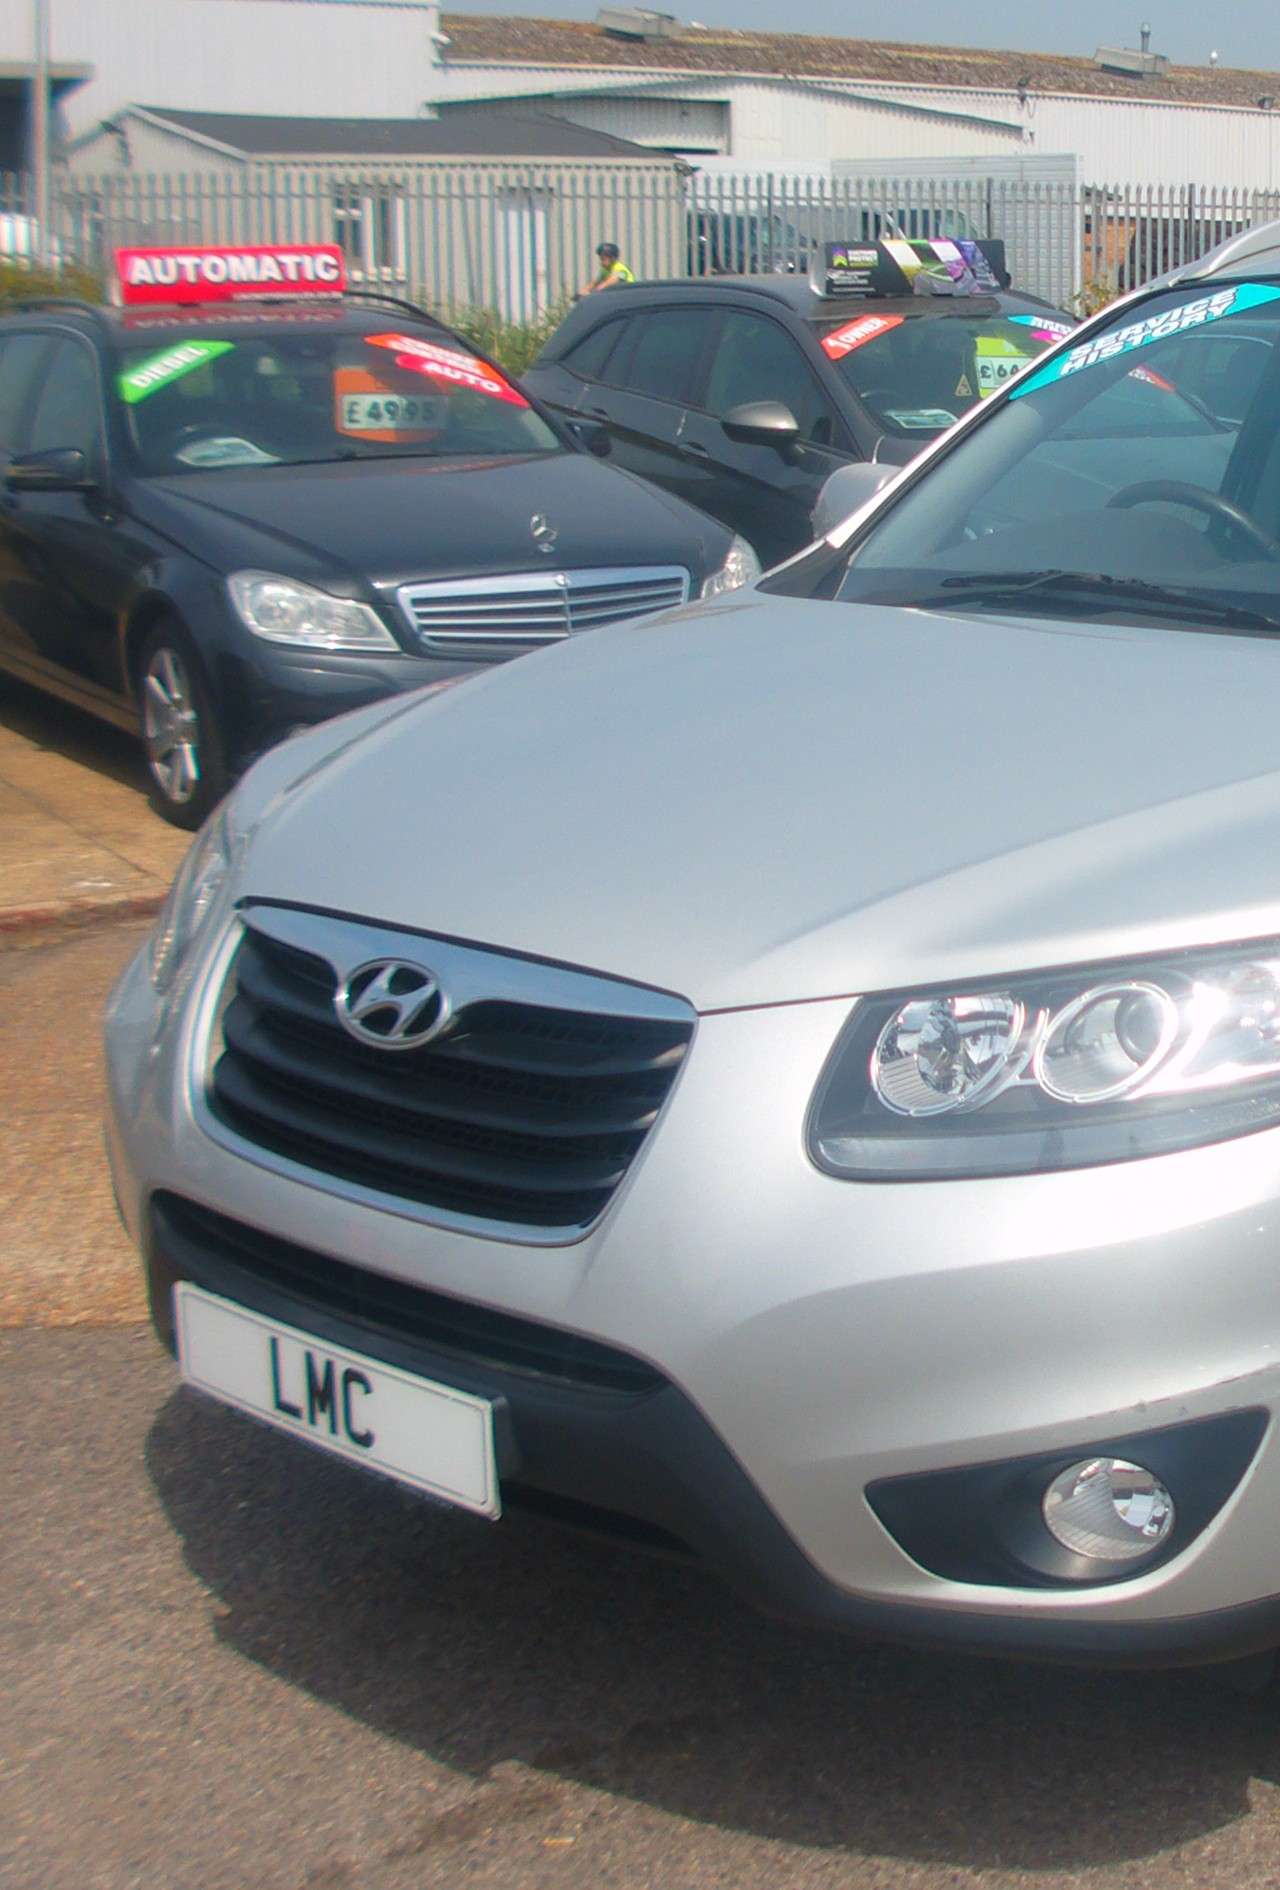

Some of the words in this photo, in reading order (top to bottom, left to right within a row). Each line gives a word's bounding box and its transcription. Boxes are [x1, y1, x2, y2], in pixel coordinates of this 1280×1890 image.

[129, 253, 339, 285] AUTOMATIC
[1060, 303, 1231, 377] HISTORY
[1069, 286, 1239, 361] SERVICE
[422, 362, 502, 393] AUTO
[267, 1335, 376, 1449] LMC
